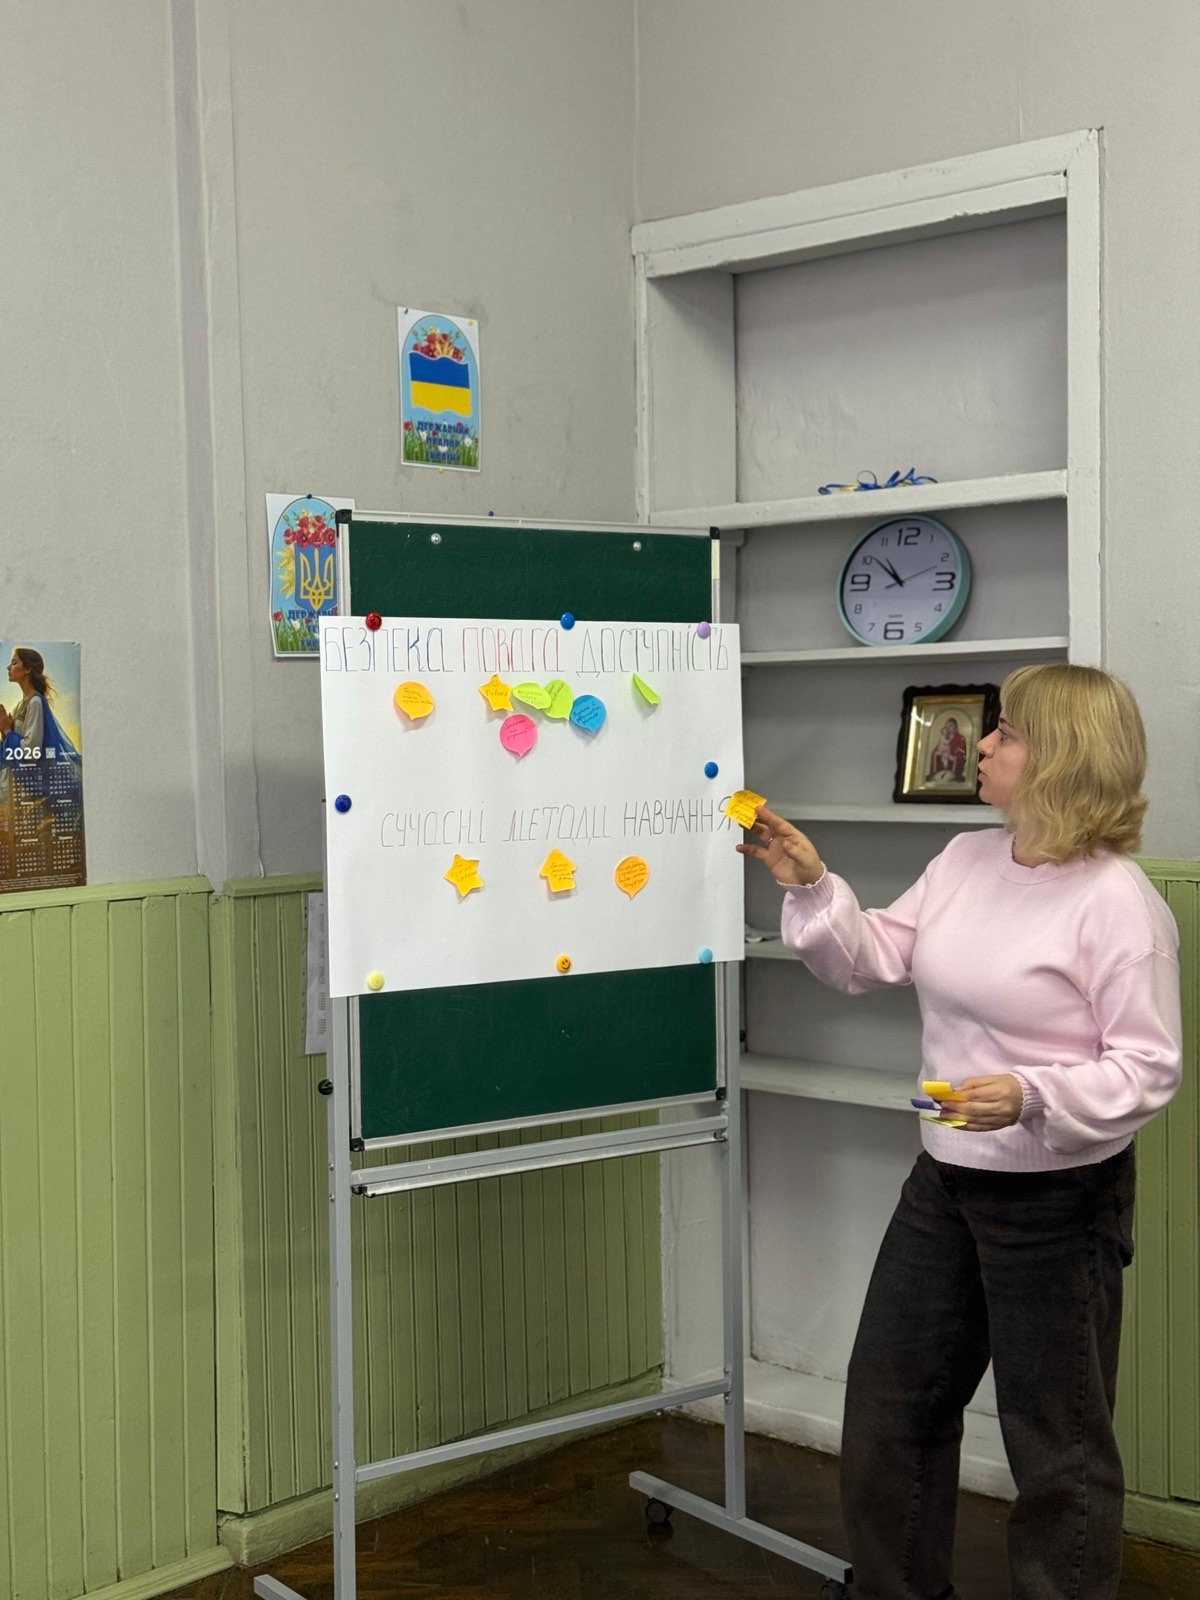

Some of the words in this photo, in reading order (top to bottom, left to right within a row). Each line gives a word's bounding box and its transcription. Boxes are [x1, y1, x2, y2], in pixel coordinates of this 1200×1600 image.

[897, 526, 921, 546] 12
[930, 534, 934, 544] 1
[881, 537, 889, 547] 11
[862, 555, 873, 565] 10
[940, 552, 950, 563] 2
[850, 573, 871, 592] 9
[932, 571, 956, 591] 3
[854, 604, 863, 614] 8
[934, 603, 942, 612] 4
[868, 622, 875, 632] 7
[883, 621, 904, 640] 6
[914, 622, 923, 632] 5
[324, 627, 454, 672] БЕЗПЕКА
[463, 628, 565, 672] ПОВАГА
[576, 625, 728, 678] ДОСТУПНІСТЬ
[5, 747, 42, 760] 2026
[381, 801, 487, 847] СУЧАСНІ
[624, 796, 732, 836] НАВЧАННЯ
